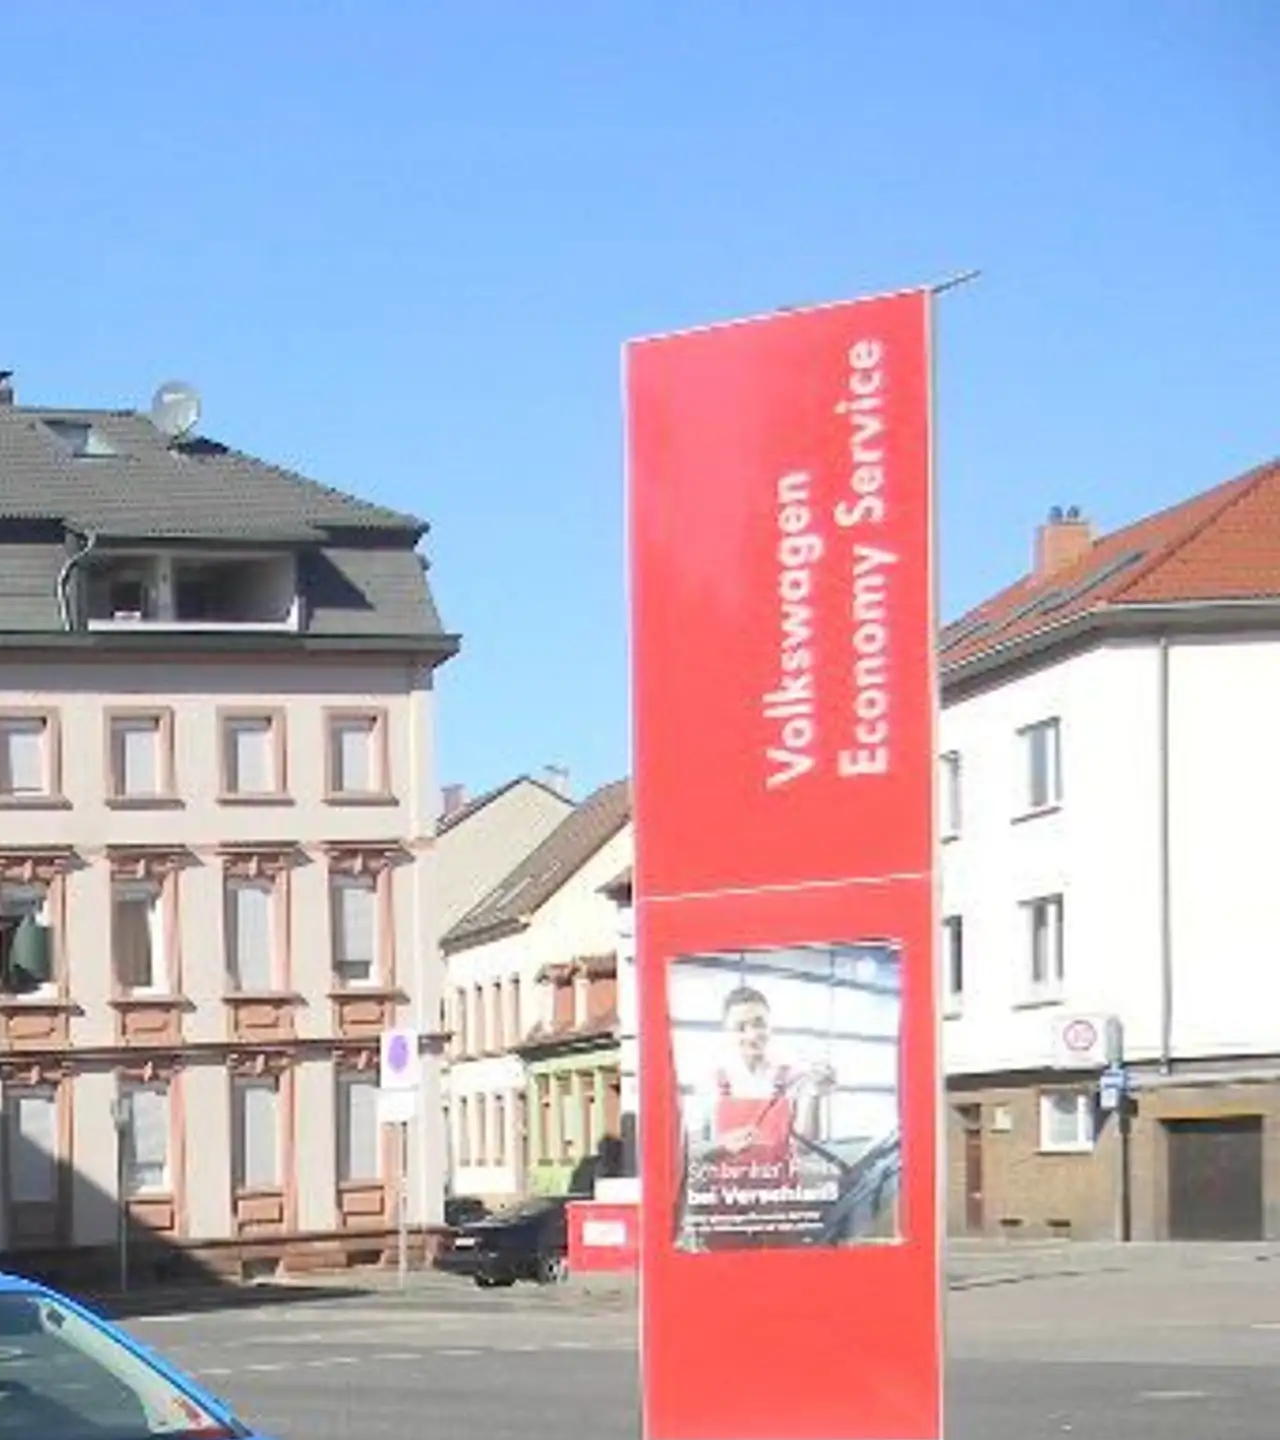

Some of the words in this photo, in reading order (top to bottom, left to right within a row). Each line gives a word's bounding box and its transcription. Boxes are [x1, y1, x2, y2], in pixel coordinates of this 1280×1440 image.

[833, 337, 885, 528] Service
[761, 469, 825, 790] Volkswagen
[836, 542, 899, 778] Economy
